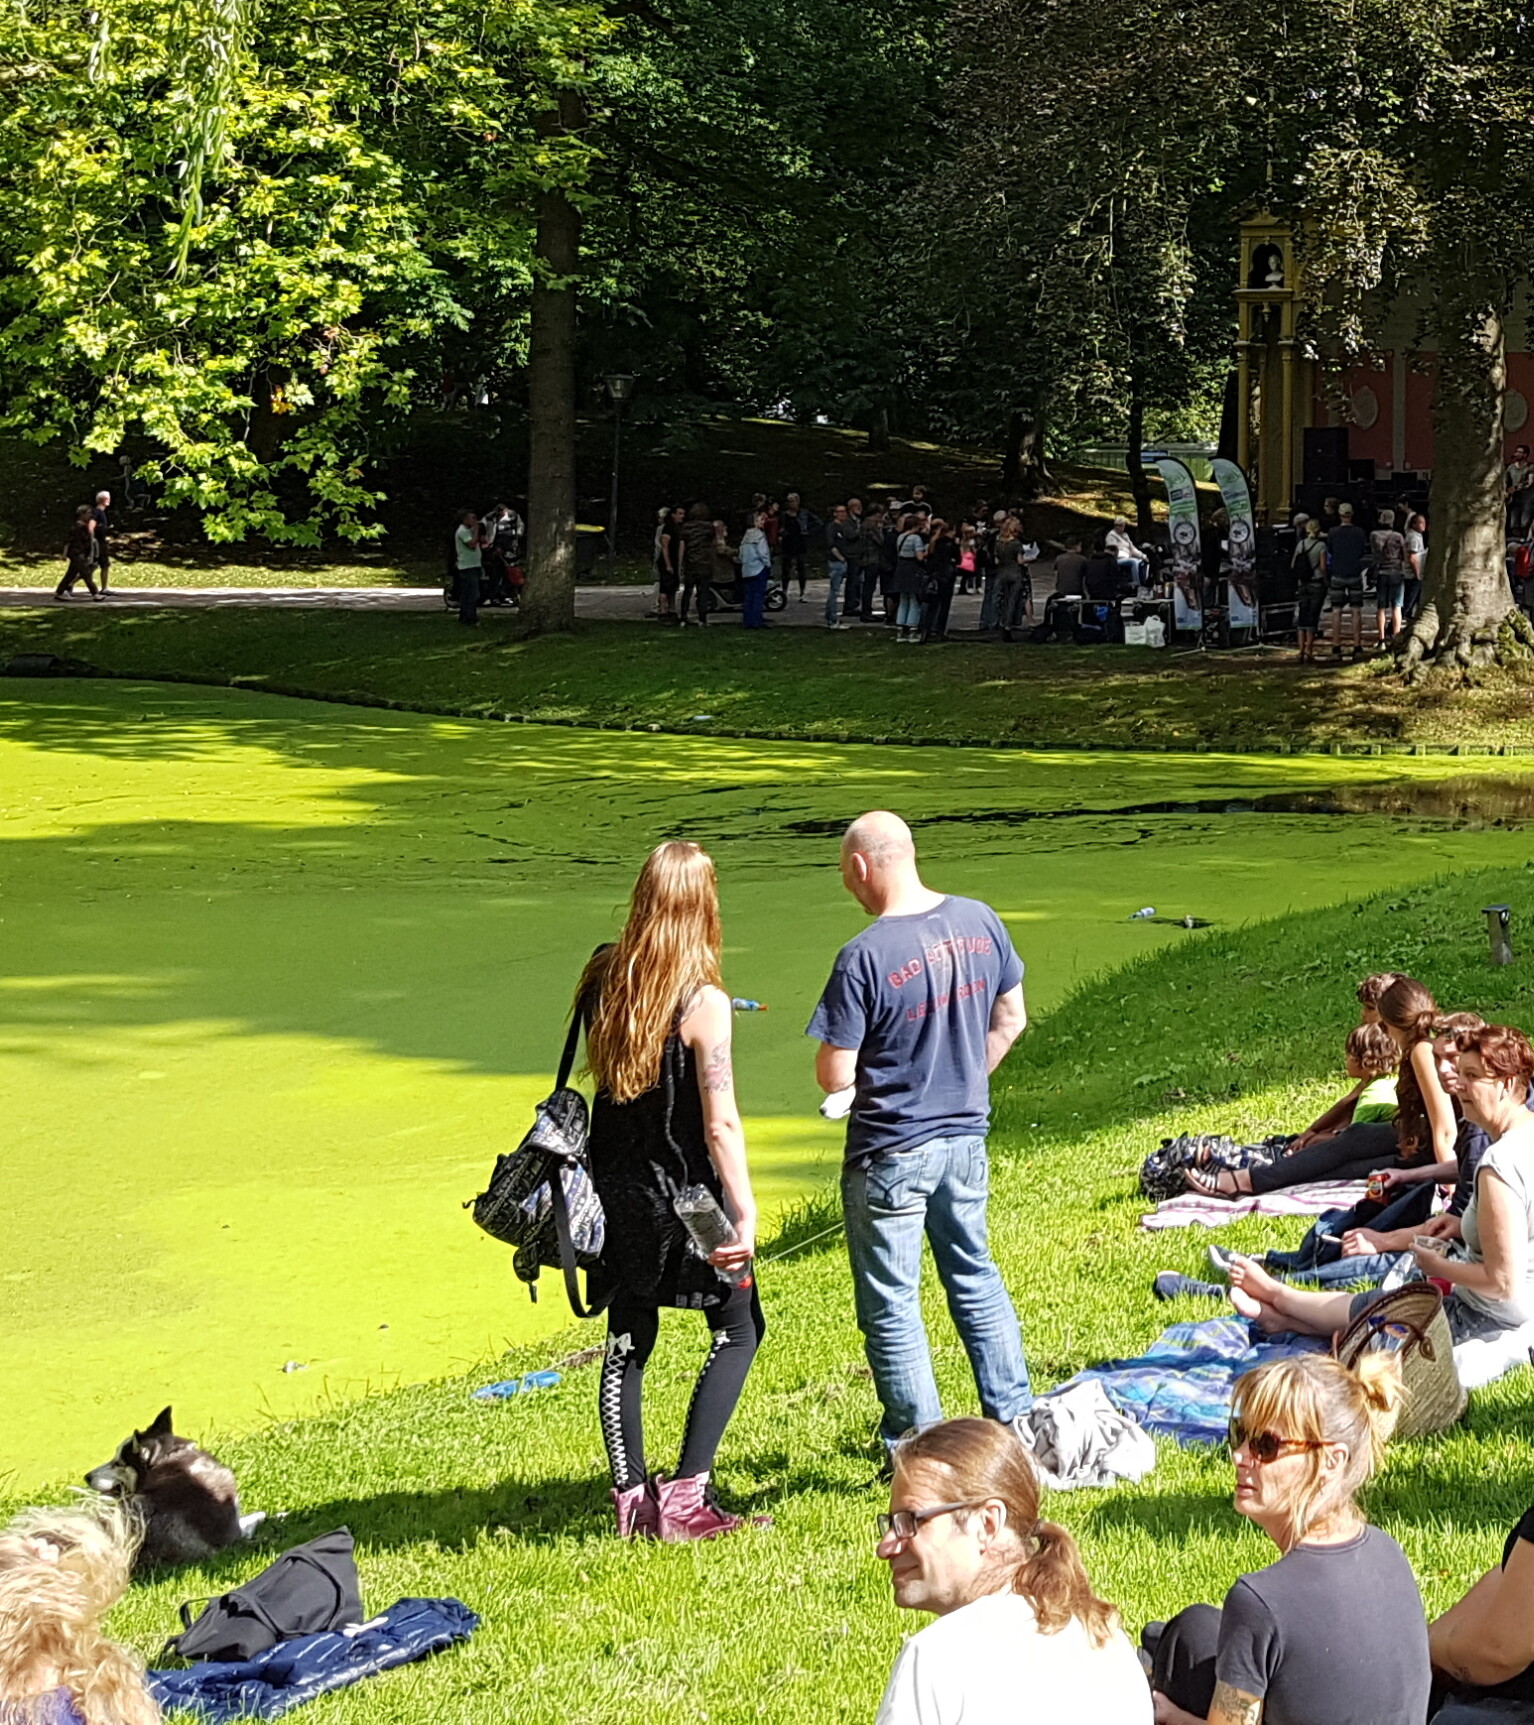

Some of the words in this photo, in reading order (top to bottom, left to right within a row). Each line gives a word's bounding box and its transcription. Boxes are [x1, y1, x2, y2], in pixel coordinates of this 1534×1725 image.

[887, 958, 922, 989] BAD
[926, 936, 992, 964] ATTTUDE
[906, 979, 986, 1021] LEEWRDEN
